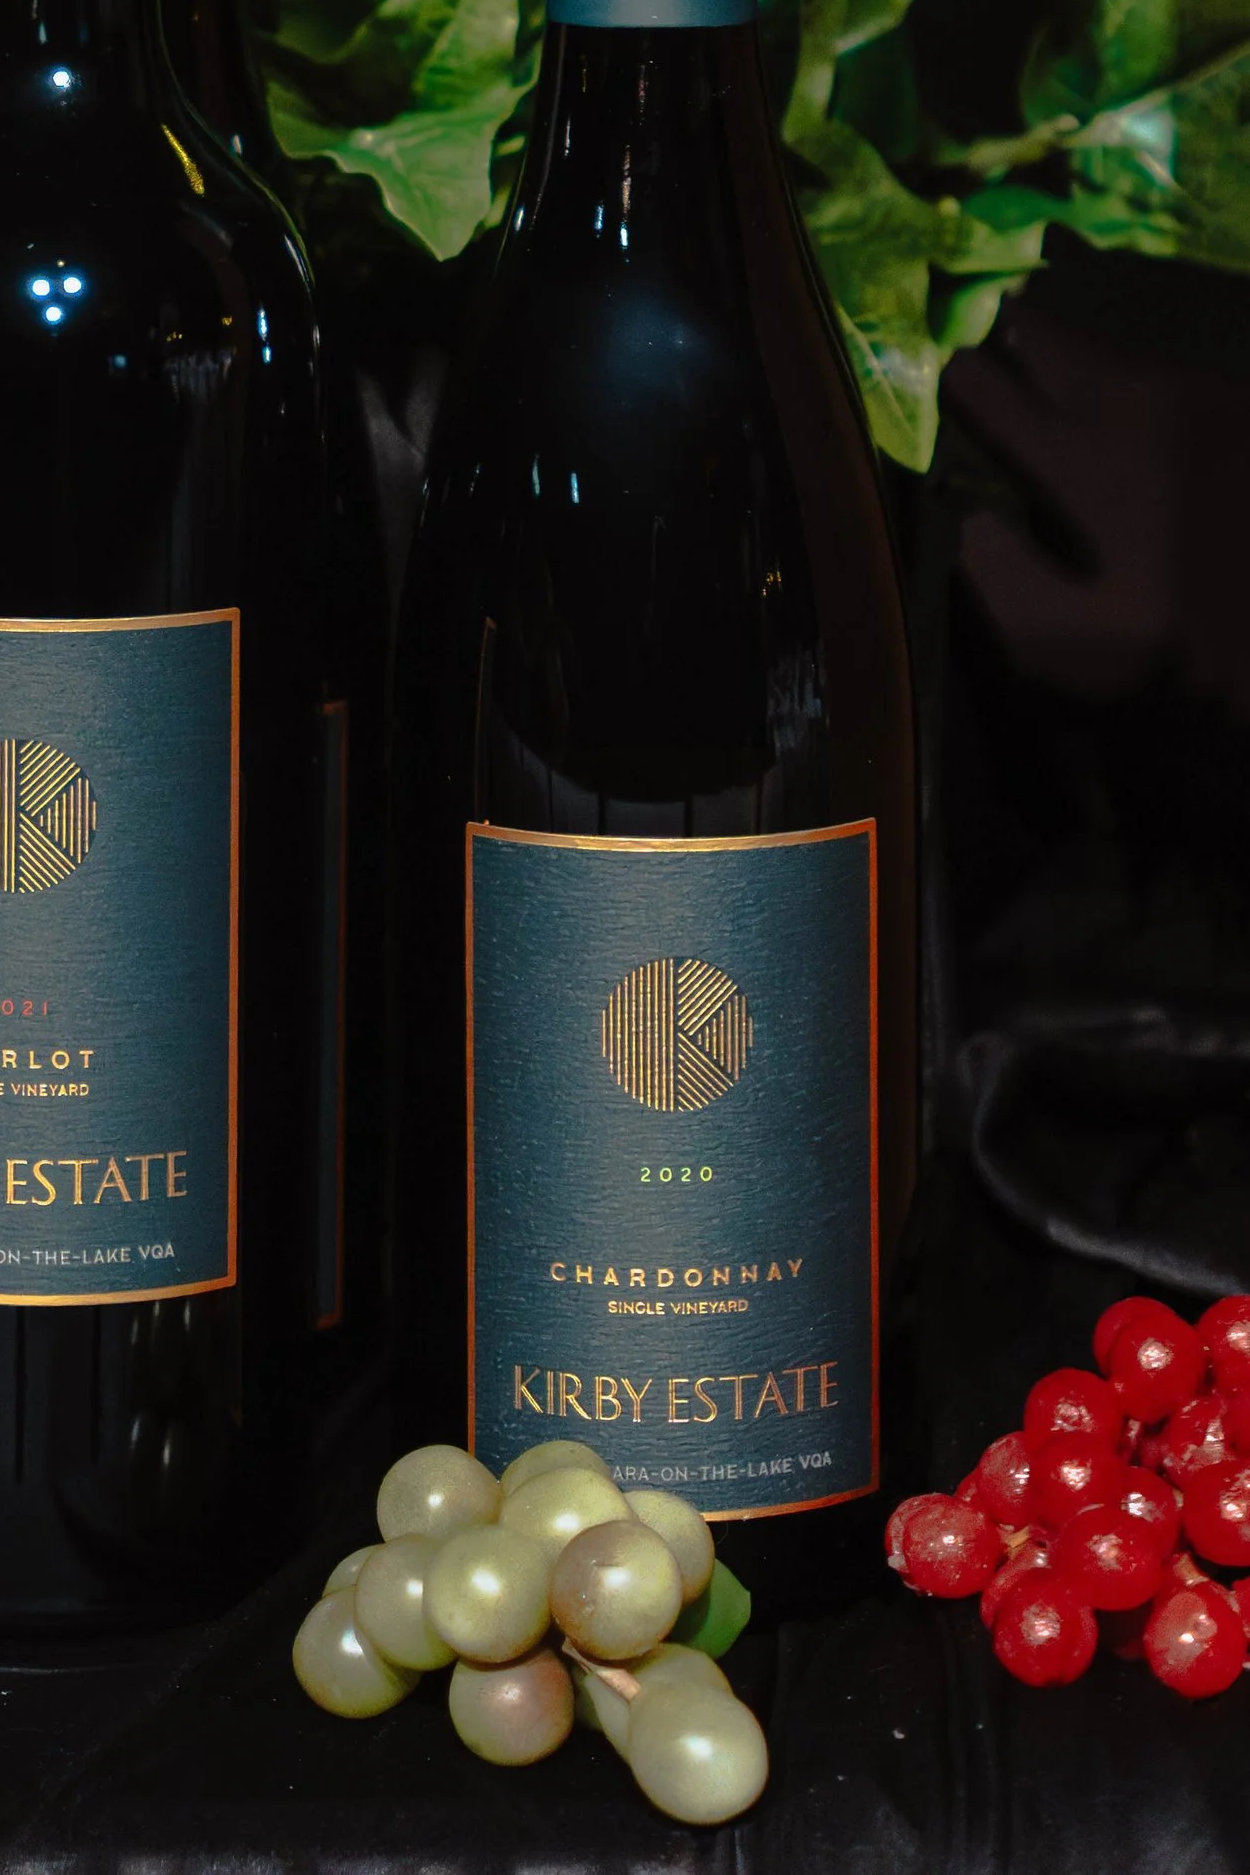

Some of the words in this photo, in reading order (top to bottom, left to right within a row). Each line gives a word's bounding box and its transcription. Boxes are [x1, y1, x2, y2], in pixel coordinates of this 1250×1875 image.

[10, 1081, 90, 1097] VINEYARD
[6, 1150, 187, 1206] ESTATE
[640, 1166, 714, 1183] 2020
[139, 1242, 175, 1260] VQA
[550, 1258, 803, 1289] CHARDONNAY
[608, 1300, 665, 1315] SINGLE
[670, 1299, 749, 1315] VINEYARD
[513, 1364, 652, 1423] KIRBY
[667, 1361, 839, 1424] ESTATE
[613, 1456, 792, 1483] ARA-ON-THE-LAKE
[800, 1450, 833, 1470] VQA
